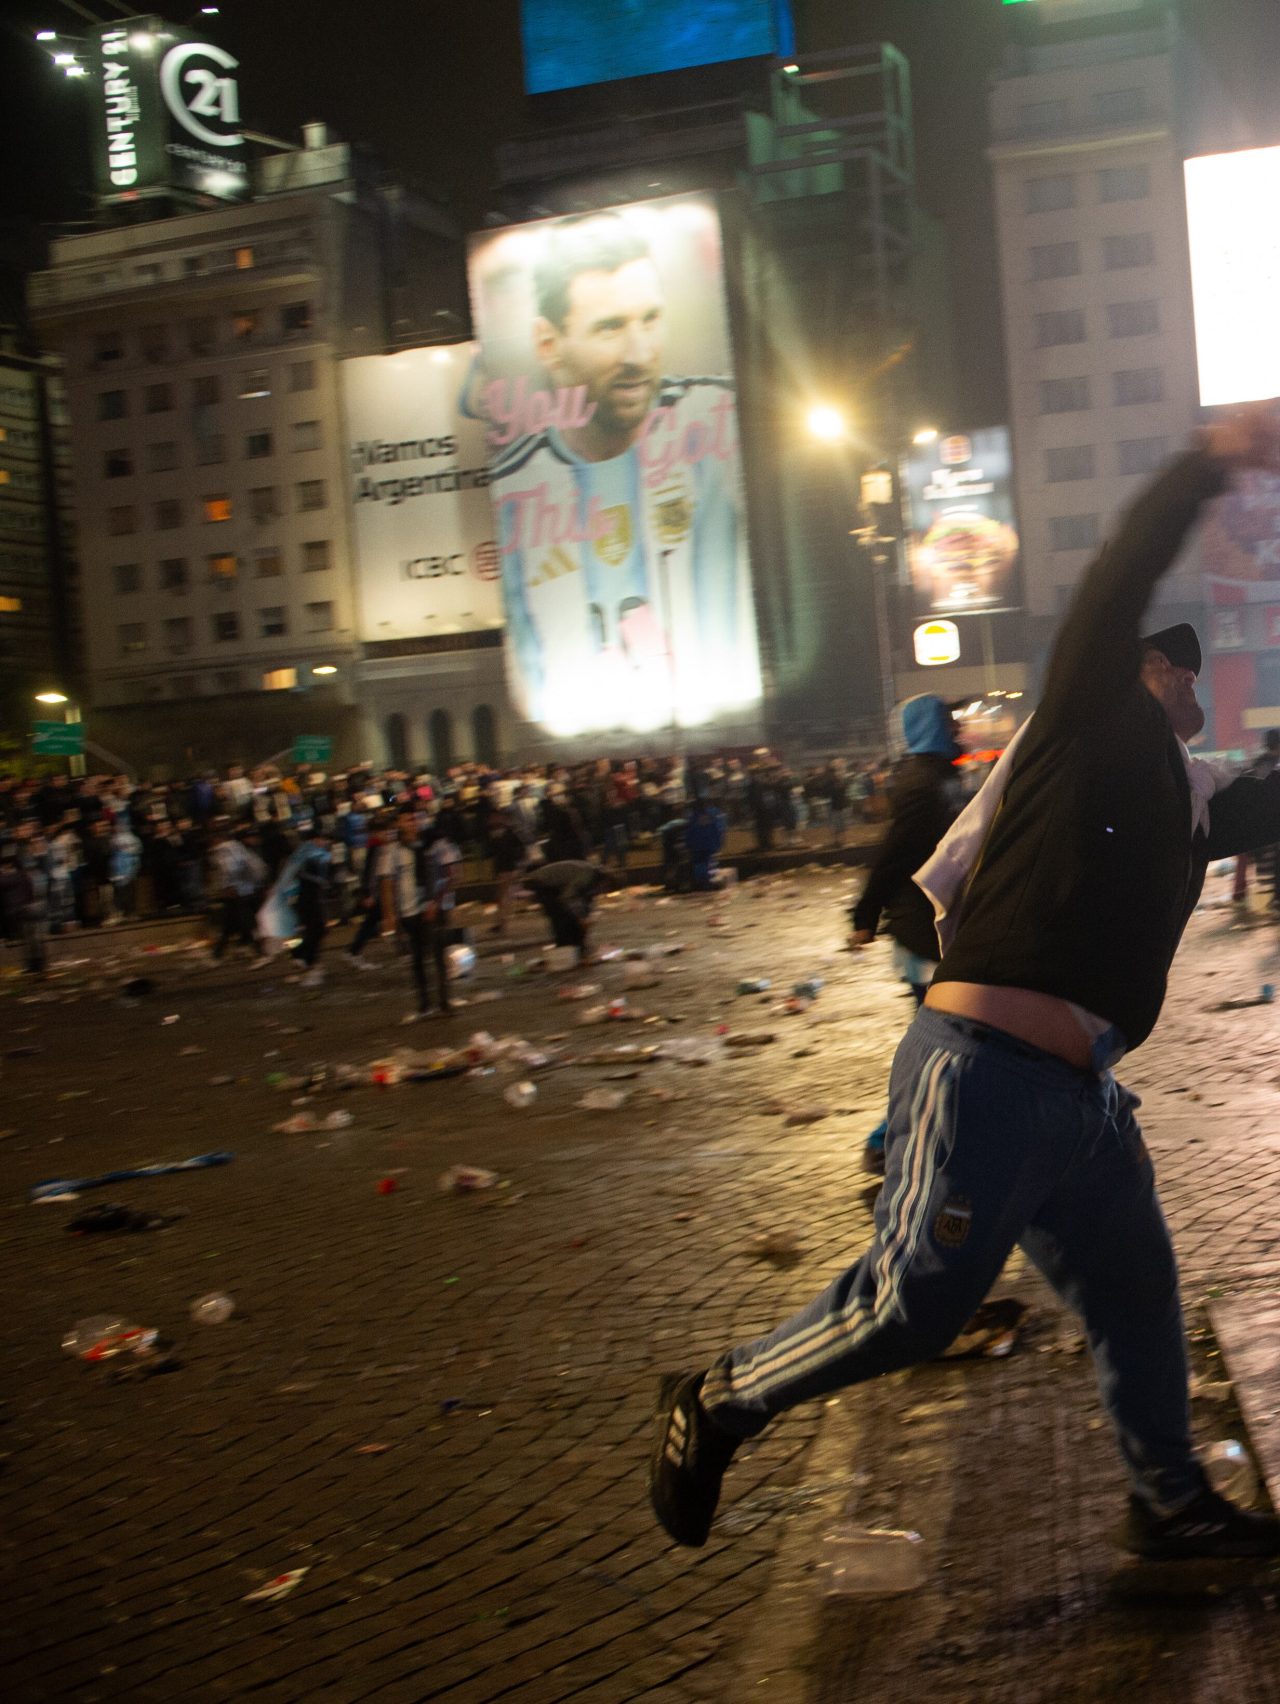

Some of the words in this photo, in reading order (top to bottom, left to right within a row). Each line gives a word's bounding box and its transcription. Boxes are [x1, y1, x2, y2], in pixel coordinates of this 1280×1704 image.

[101, 62, 138, 186] CENTURY
[484, 373, 599, 446] You
[636, 390, 738, 489] Got
[498, 482, 619, 555] This
